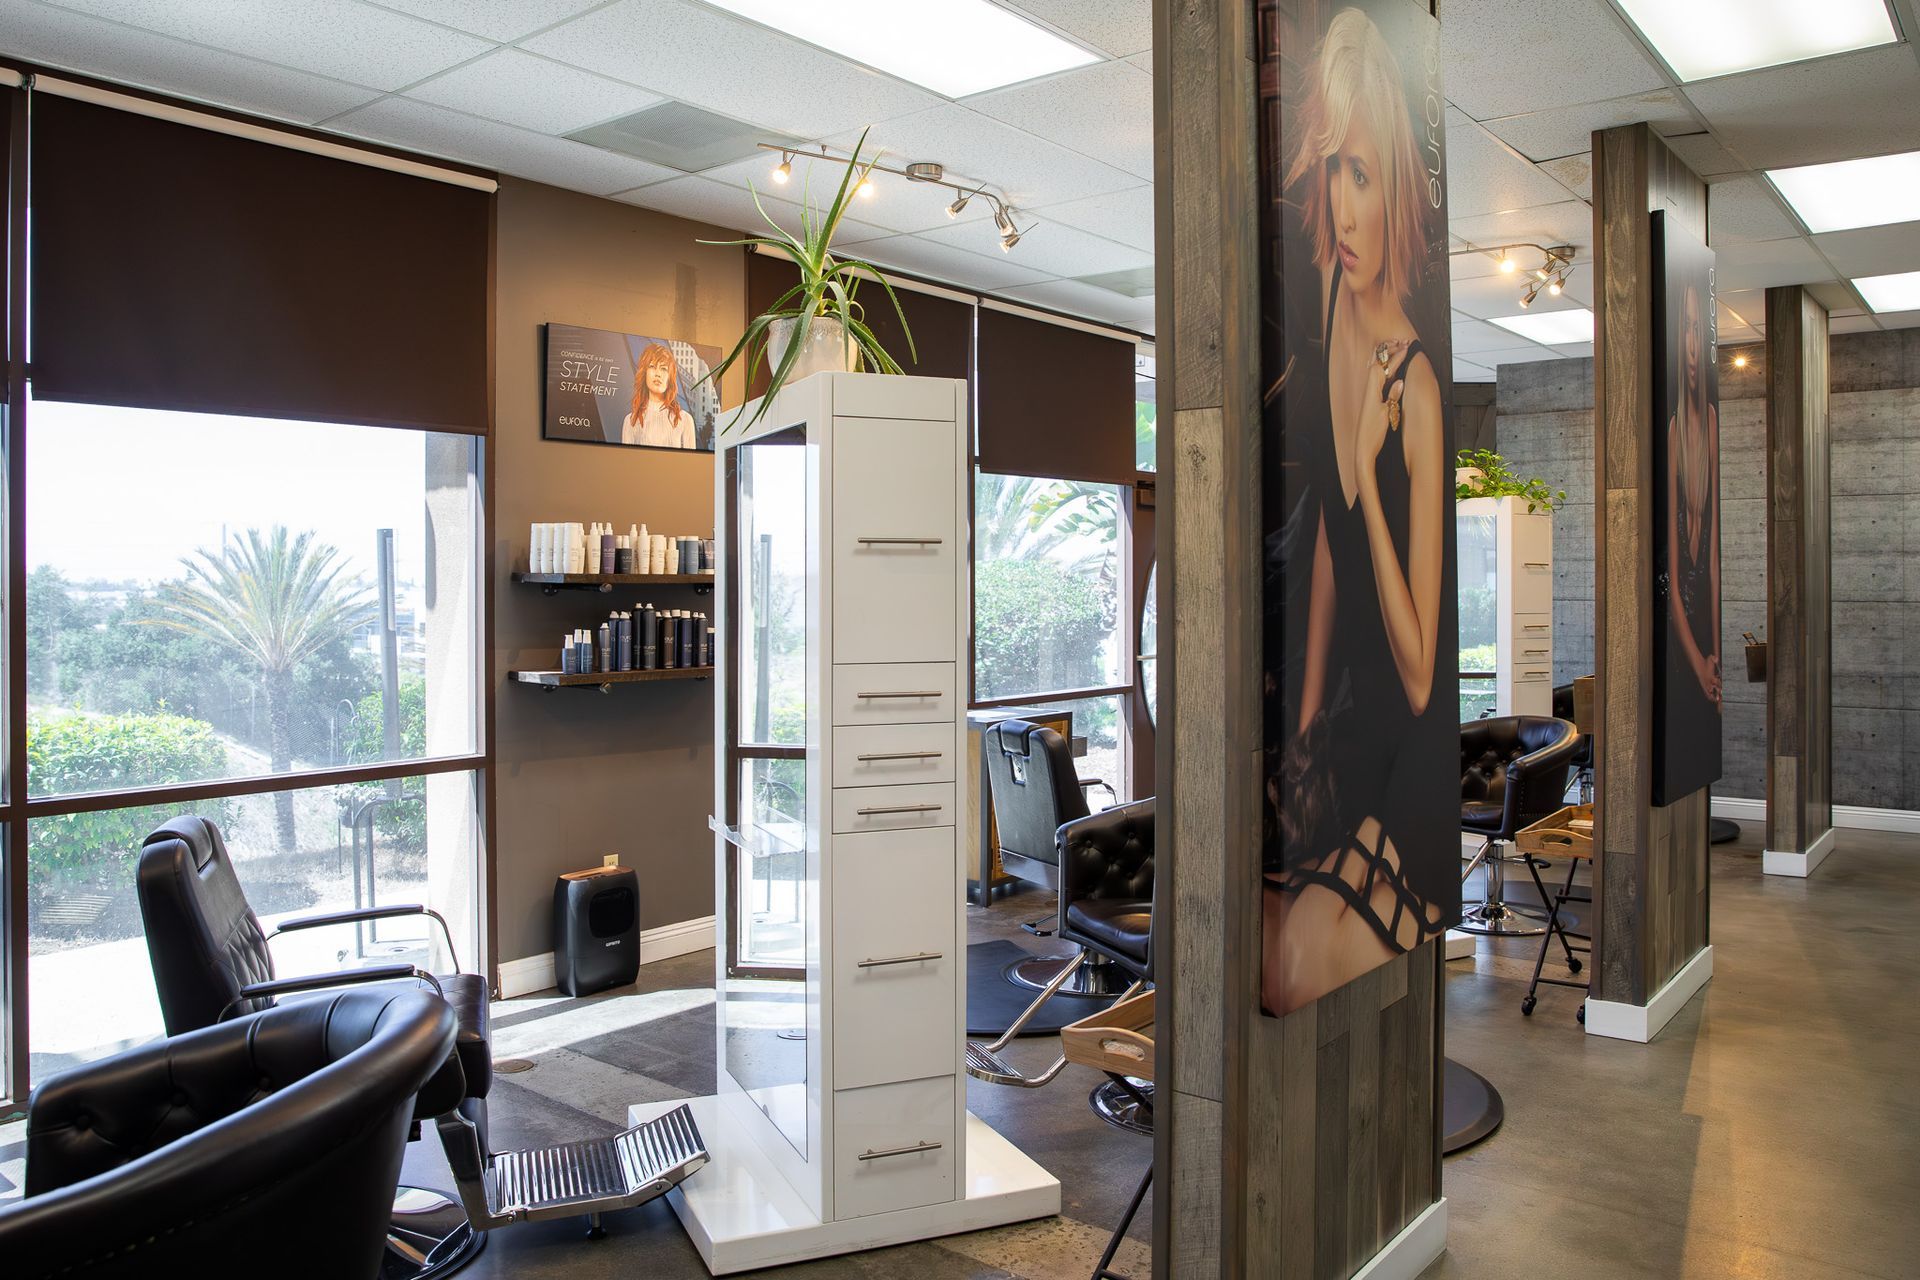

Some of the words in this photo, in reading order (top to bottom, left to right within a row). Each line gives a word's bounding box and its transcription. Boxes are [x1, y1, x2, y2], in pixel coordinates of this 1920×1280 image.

[1425, 45, 1442, 209] eufora
[1709, 268, 1717, 364] eufora
[560, 360, 620, 384] STYLE
[560, 381, 619, 397] STATEMENT
[559, 415, 591, 428] eufora
